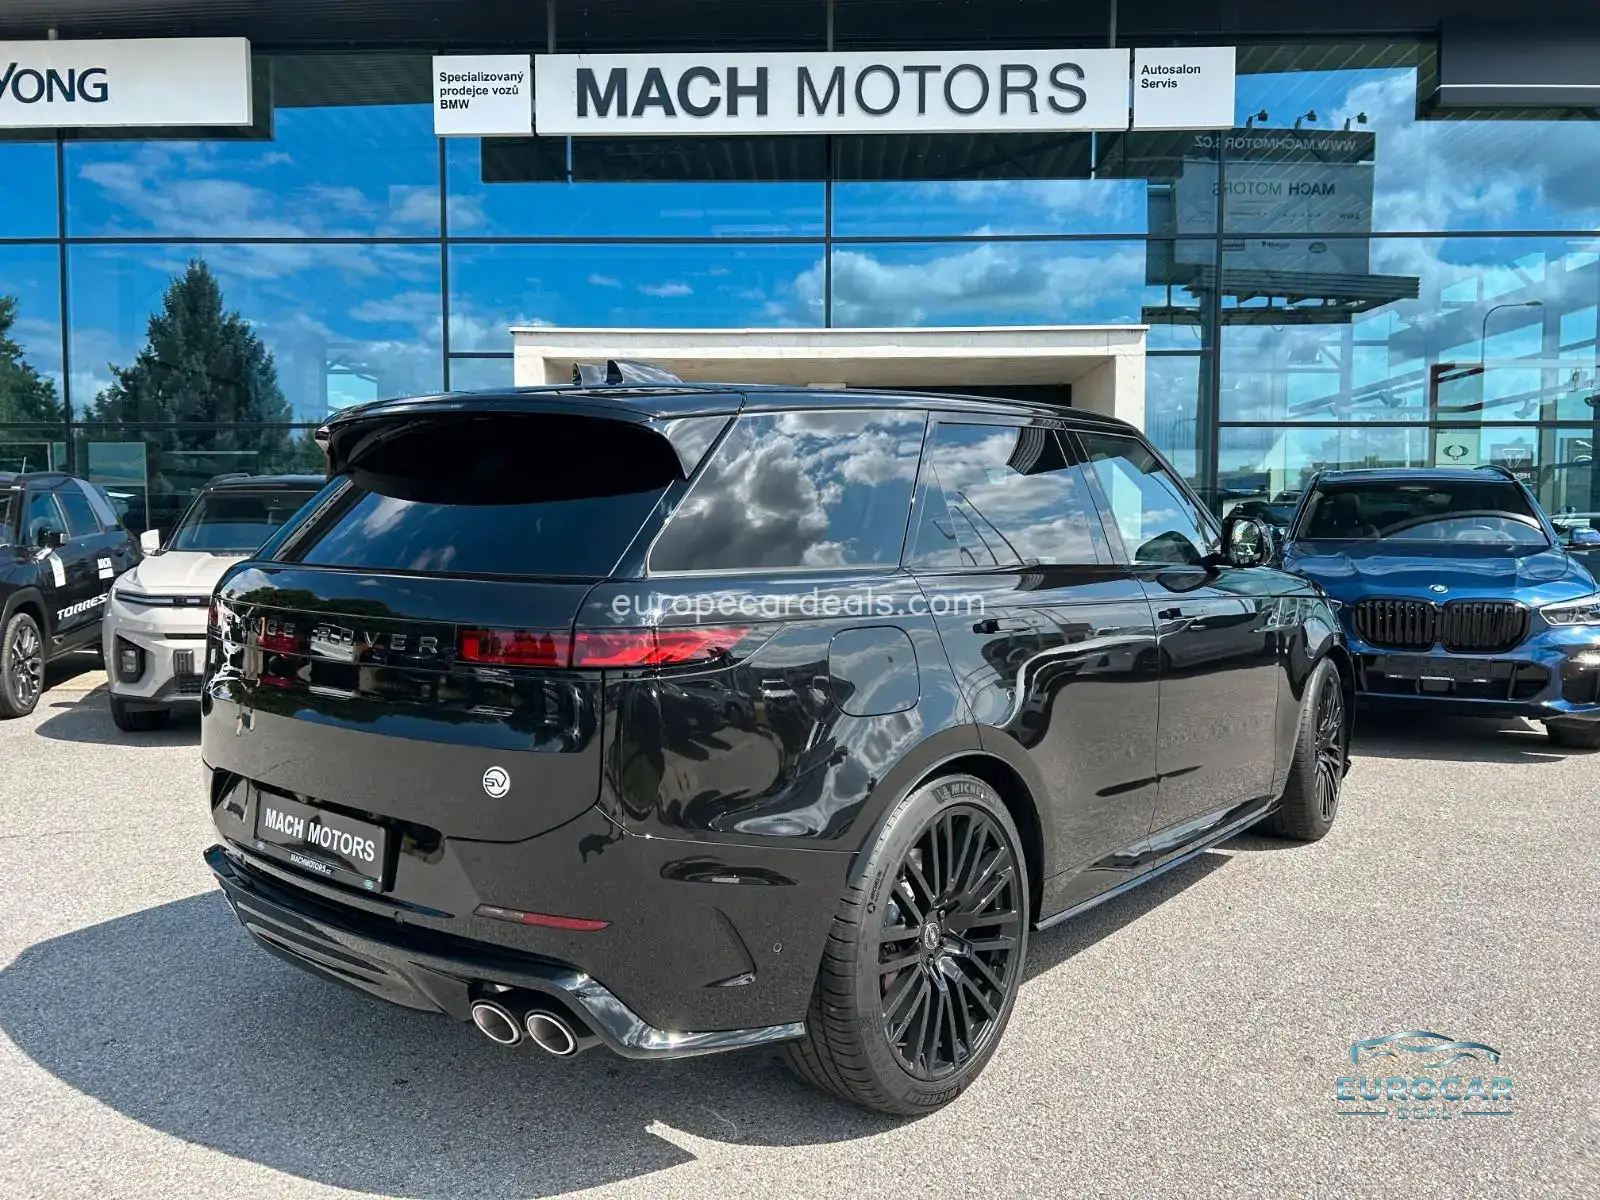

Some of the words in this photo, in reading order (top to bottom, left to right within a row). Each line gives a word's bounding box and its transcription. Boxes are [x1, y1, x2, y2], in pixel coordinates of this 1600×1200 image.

[1141, 64, 1201, 75] Autosalon
[439, 71, 524, 84] Specializovaný
[1141, 78, 1178, 88] Servis
[440, 86, 489, 98] prodejce
[491, 85, 519, 95] vozů
[576, 66, 769, 119] MACH
[797, 62, 1087, 117] MOTORS
[440, 99, 470, 110] BMW
[57, 593, 108, 620] TORRES
[265, 807, 304, 838] MACH
[307, 822, 375, 862] MOTORS
